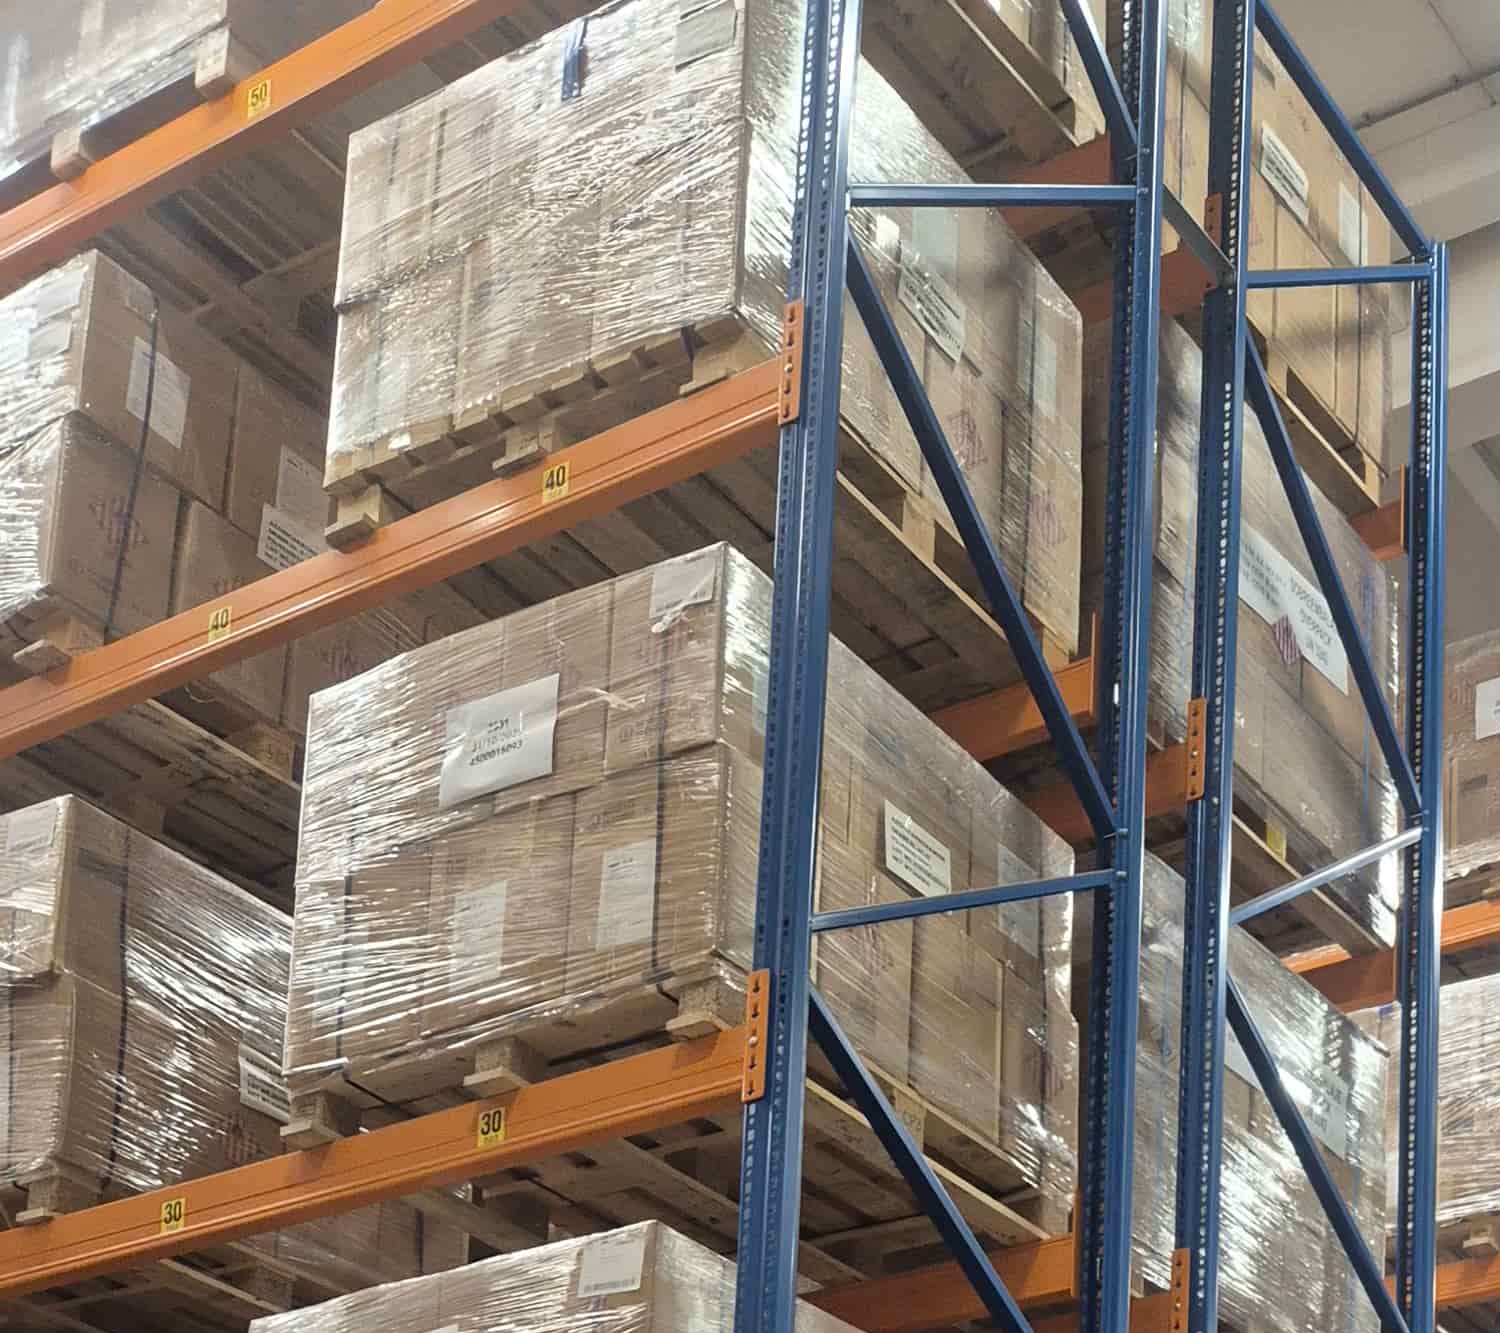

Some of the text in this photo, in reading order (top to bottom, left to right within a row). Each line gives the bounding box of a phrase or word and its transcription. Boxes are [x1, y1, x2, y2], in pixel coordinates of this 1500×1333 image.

[251, 83, 267, 106] 50
[545, 465, 566, 490] 40
[212, 607, 228, 630] 40
[480, 1109, 502, 1136] 30
[163, 1201, 182, 1225] 30
